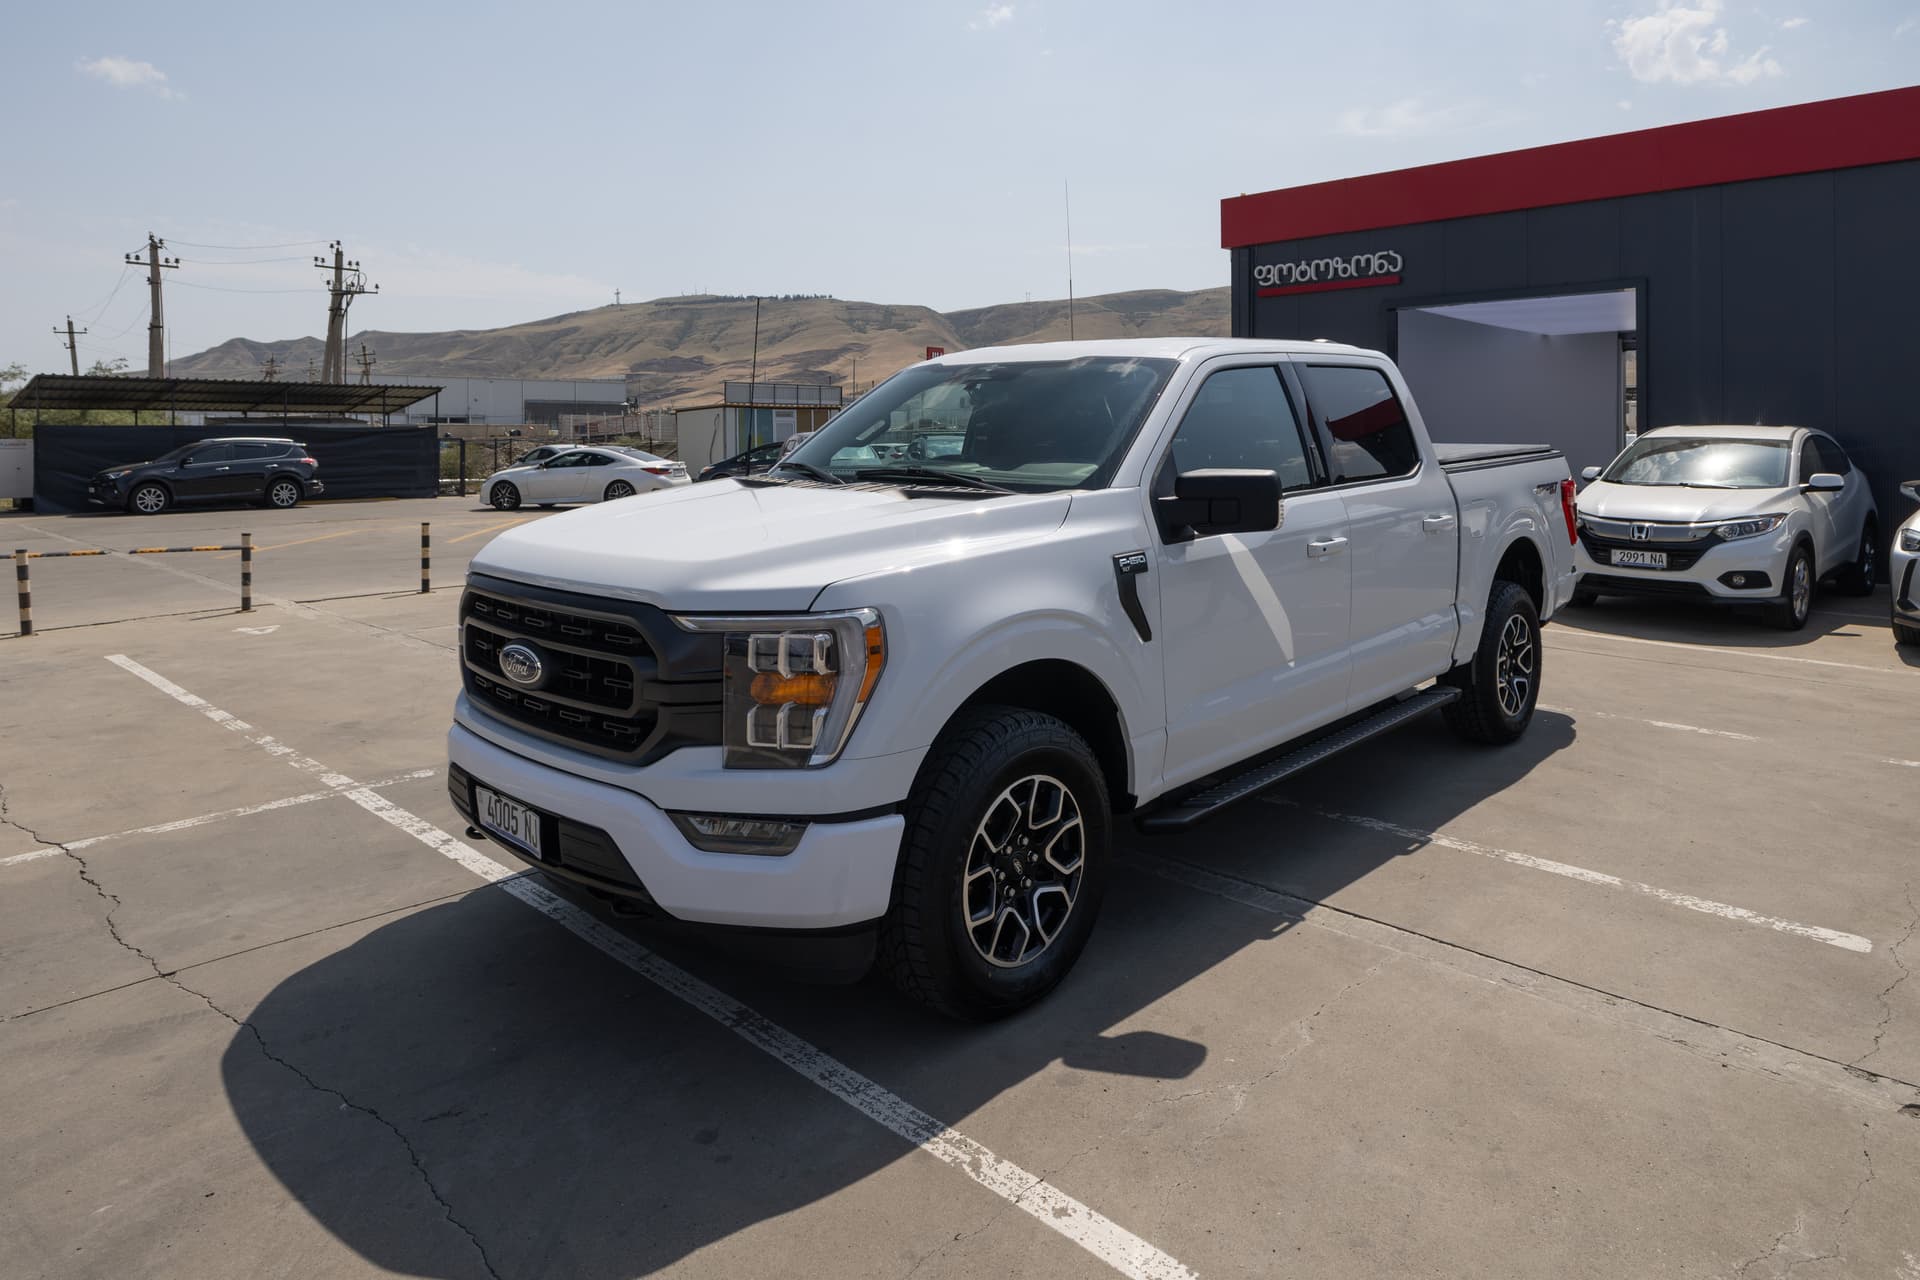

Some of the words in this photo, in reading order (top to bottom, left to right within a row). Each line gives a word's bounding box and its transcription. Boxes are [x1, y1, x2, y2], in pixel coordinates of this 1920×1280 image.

[1254, 250, 1403, 286] ფოტოზონა
[1619, 551, 1645, 563] 2991
[1650, 553, 1664, 565] NA
[506, 652, 530, 676] Ford
[487, 795, 519, 836] 4005
